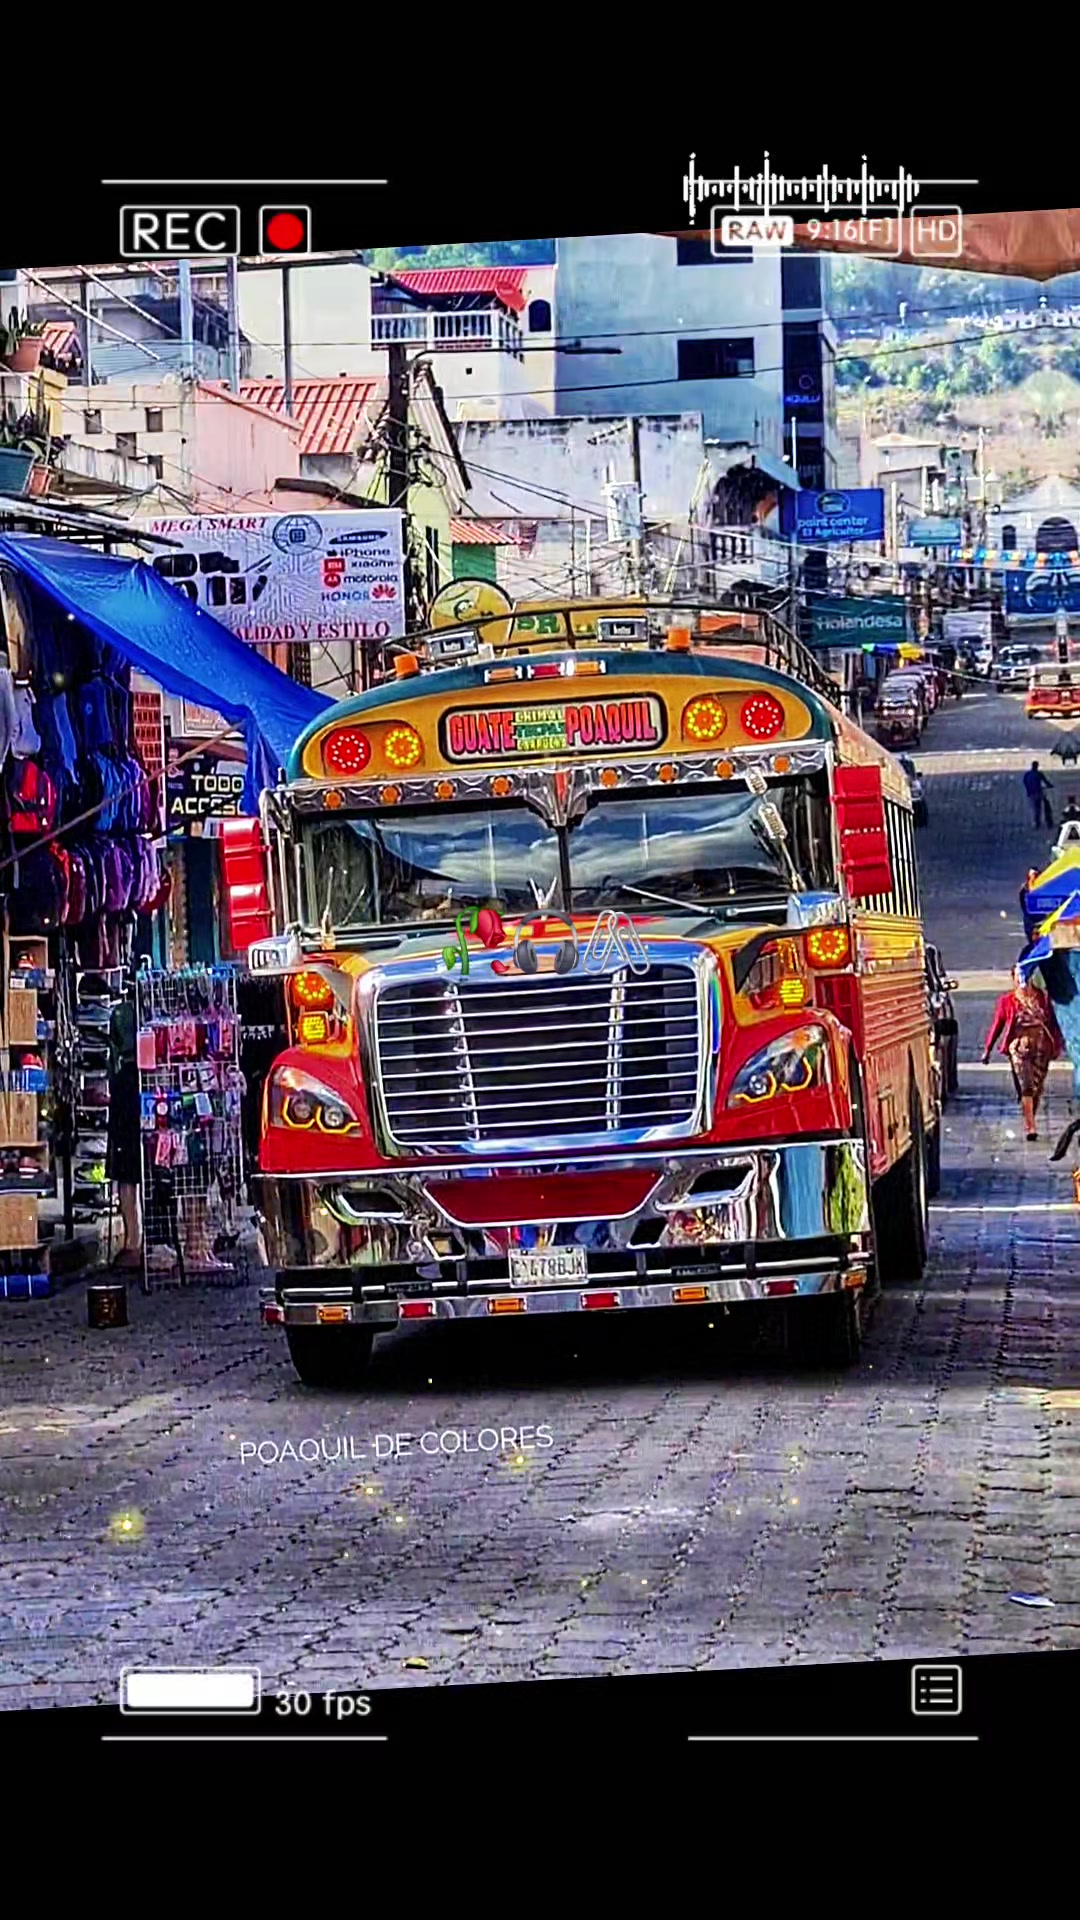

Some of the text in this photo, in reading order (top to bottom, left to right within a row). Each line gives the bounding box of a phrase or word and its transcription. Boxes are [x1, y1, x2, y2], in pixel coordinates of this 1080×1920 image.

[151, 517, 268, 534] MEGA SMART
[829, 515, 868, 528] center
[340, 548, 391, 558] iPhone
[343, 573, 398, 584] motorola
[321, 590, 370, 602] HONOR
[235, 620, 390, 641] ALIDAD Y ESTILO
[449, 711, 516, 755] GUATE
[565, 702, 656, 744] POAQUIL
[191, 774, 245, 794] TODO
